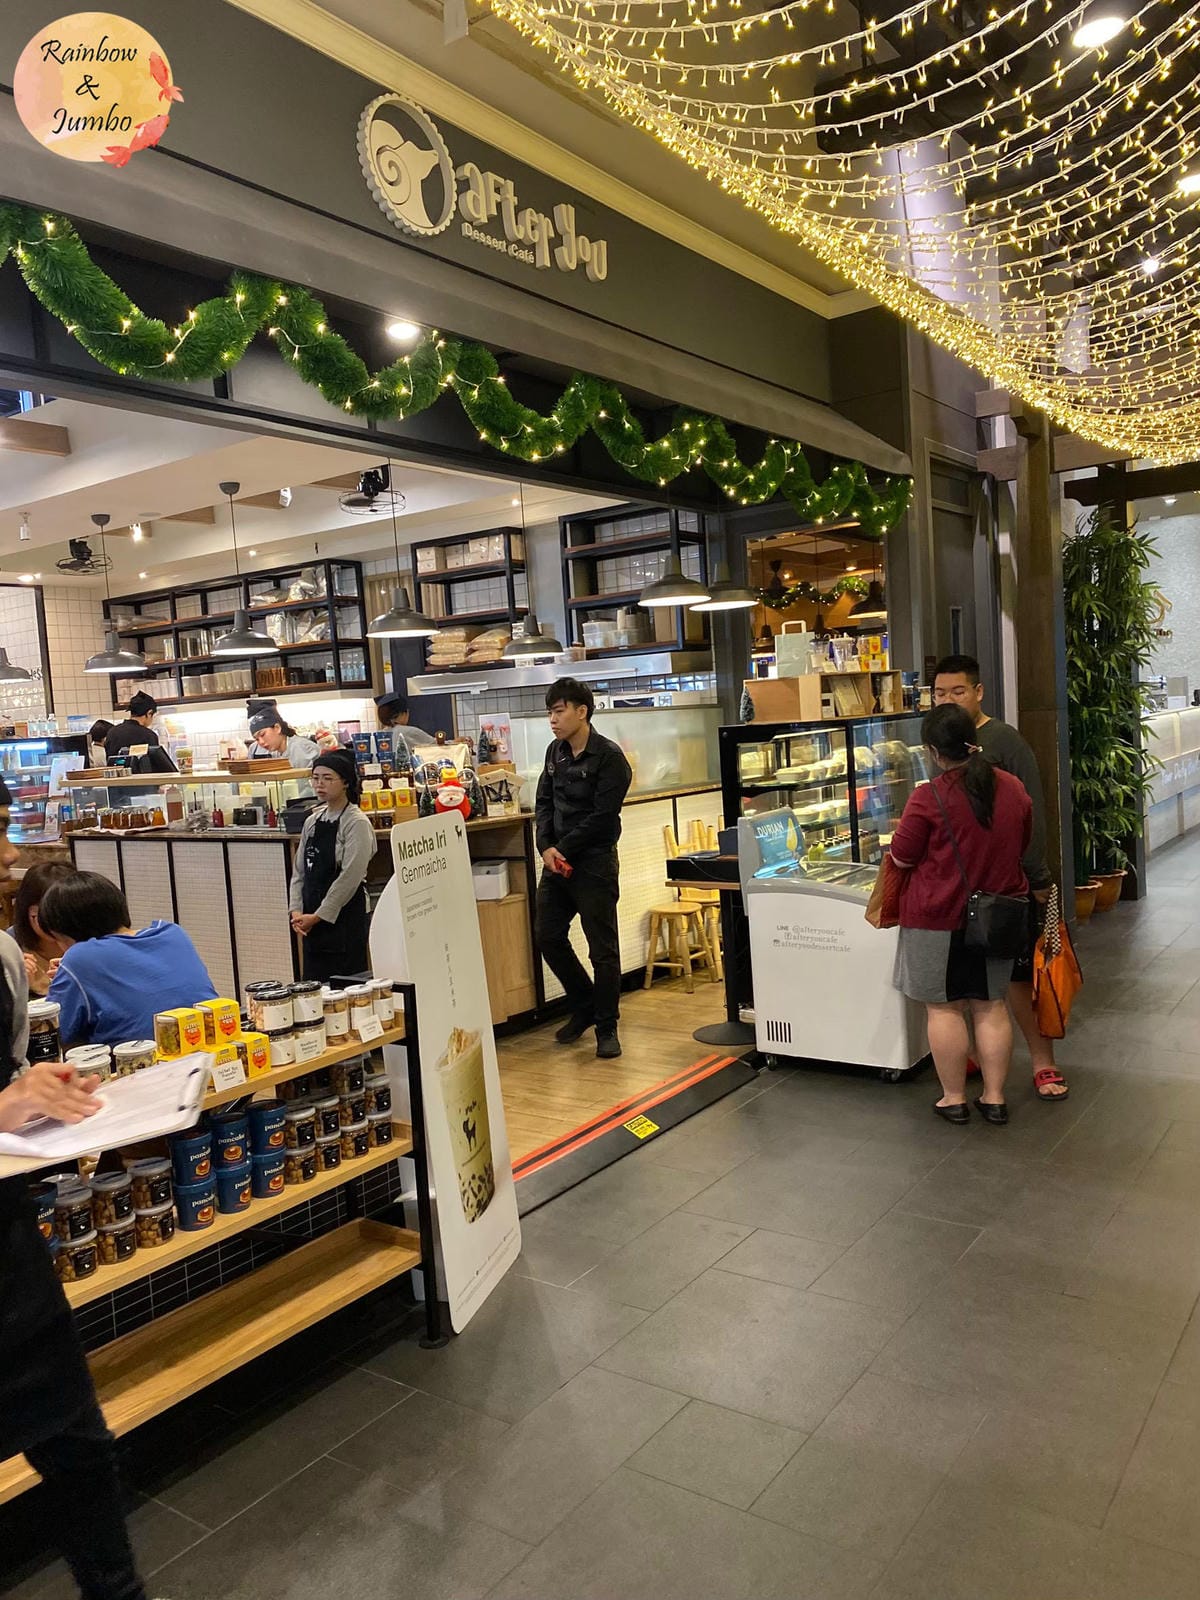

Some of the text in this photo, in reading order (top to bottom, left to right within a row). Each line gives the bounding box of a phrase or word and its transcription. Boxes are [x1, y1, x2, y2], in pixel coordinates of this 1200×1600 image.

[461, 222, 535, 264] Dessert Café
[756, 820, 785, 836] DURIAN
[398, 829, 447, 862] Matcha Iri
[401, 856, 447, 884] Genmaicha
